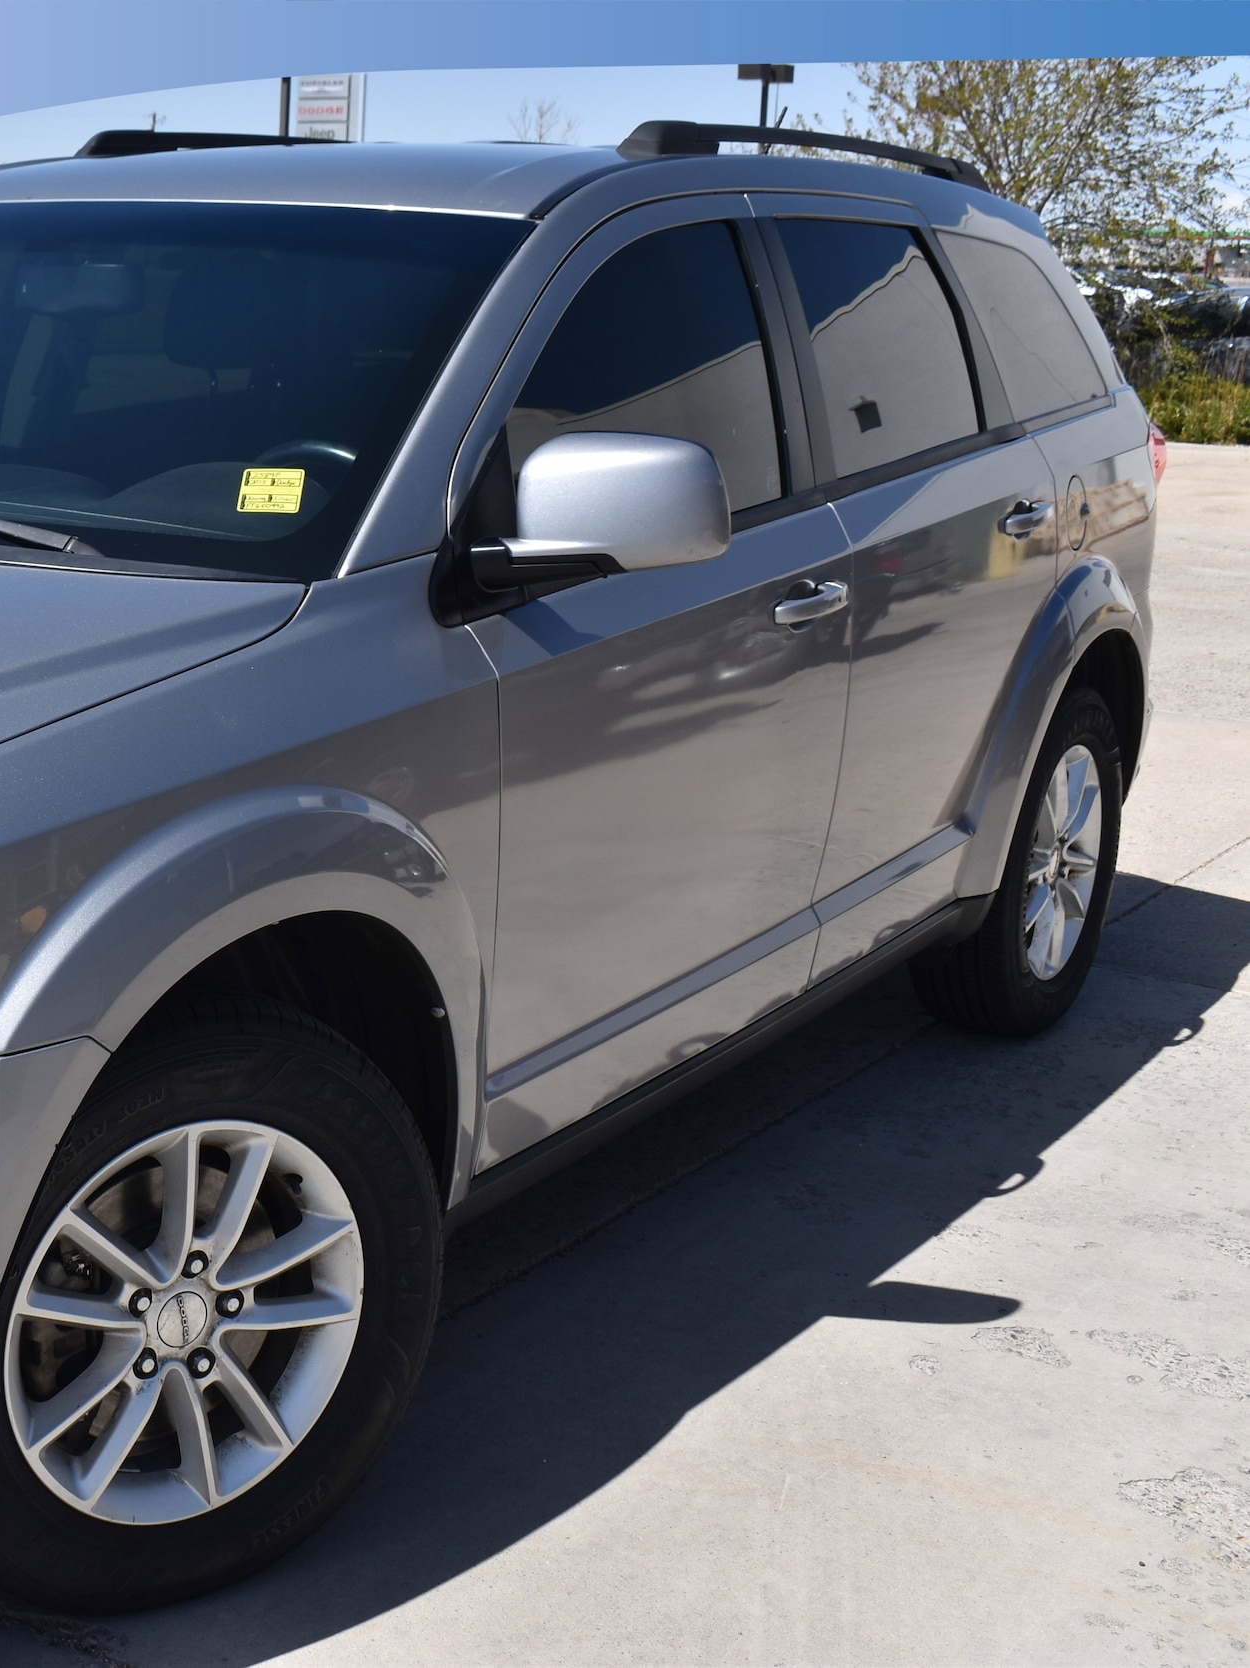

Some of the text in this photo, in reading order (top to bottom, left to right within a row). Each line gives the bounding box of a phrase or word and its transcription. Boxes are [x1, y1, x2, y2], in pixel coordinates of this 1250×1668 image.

[298, 106, 345, 115] DODGE
[304, 125, 336, 140] Jeep
[176, 1295, 189, 1344] DODGE
